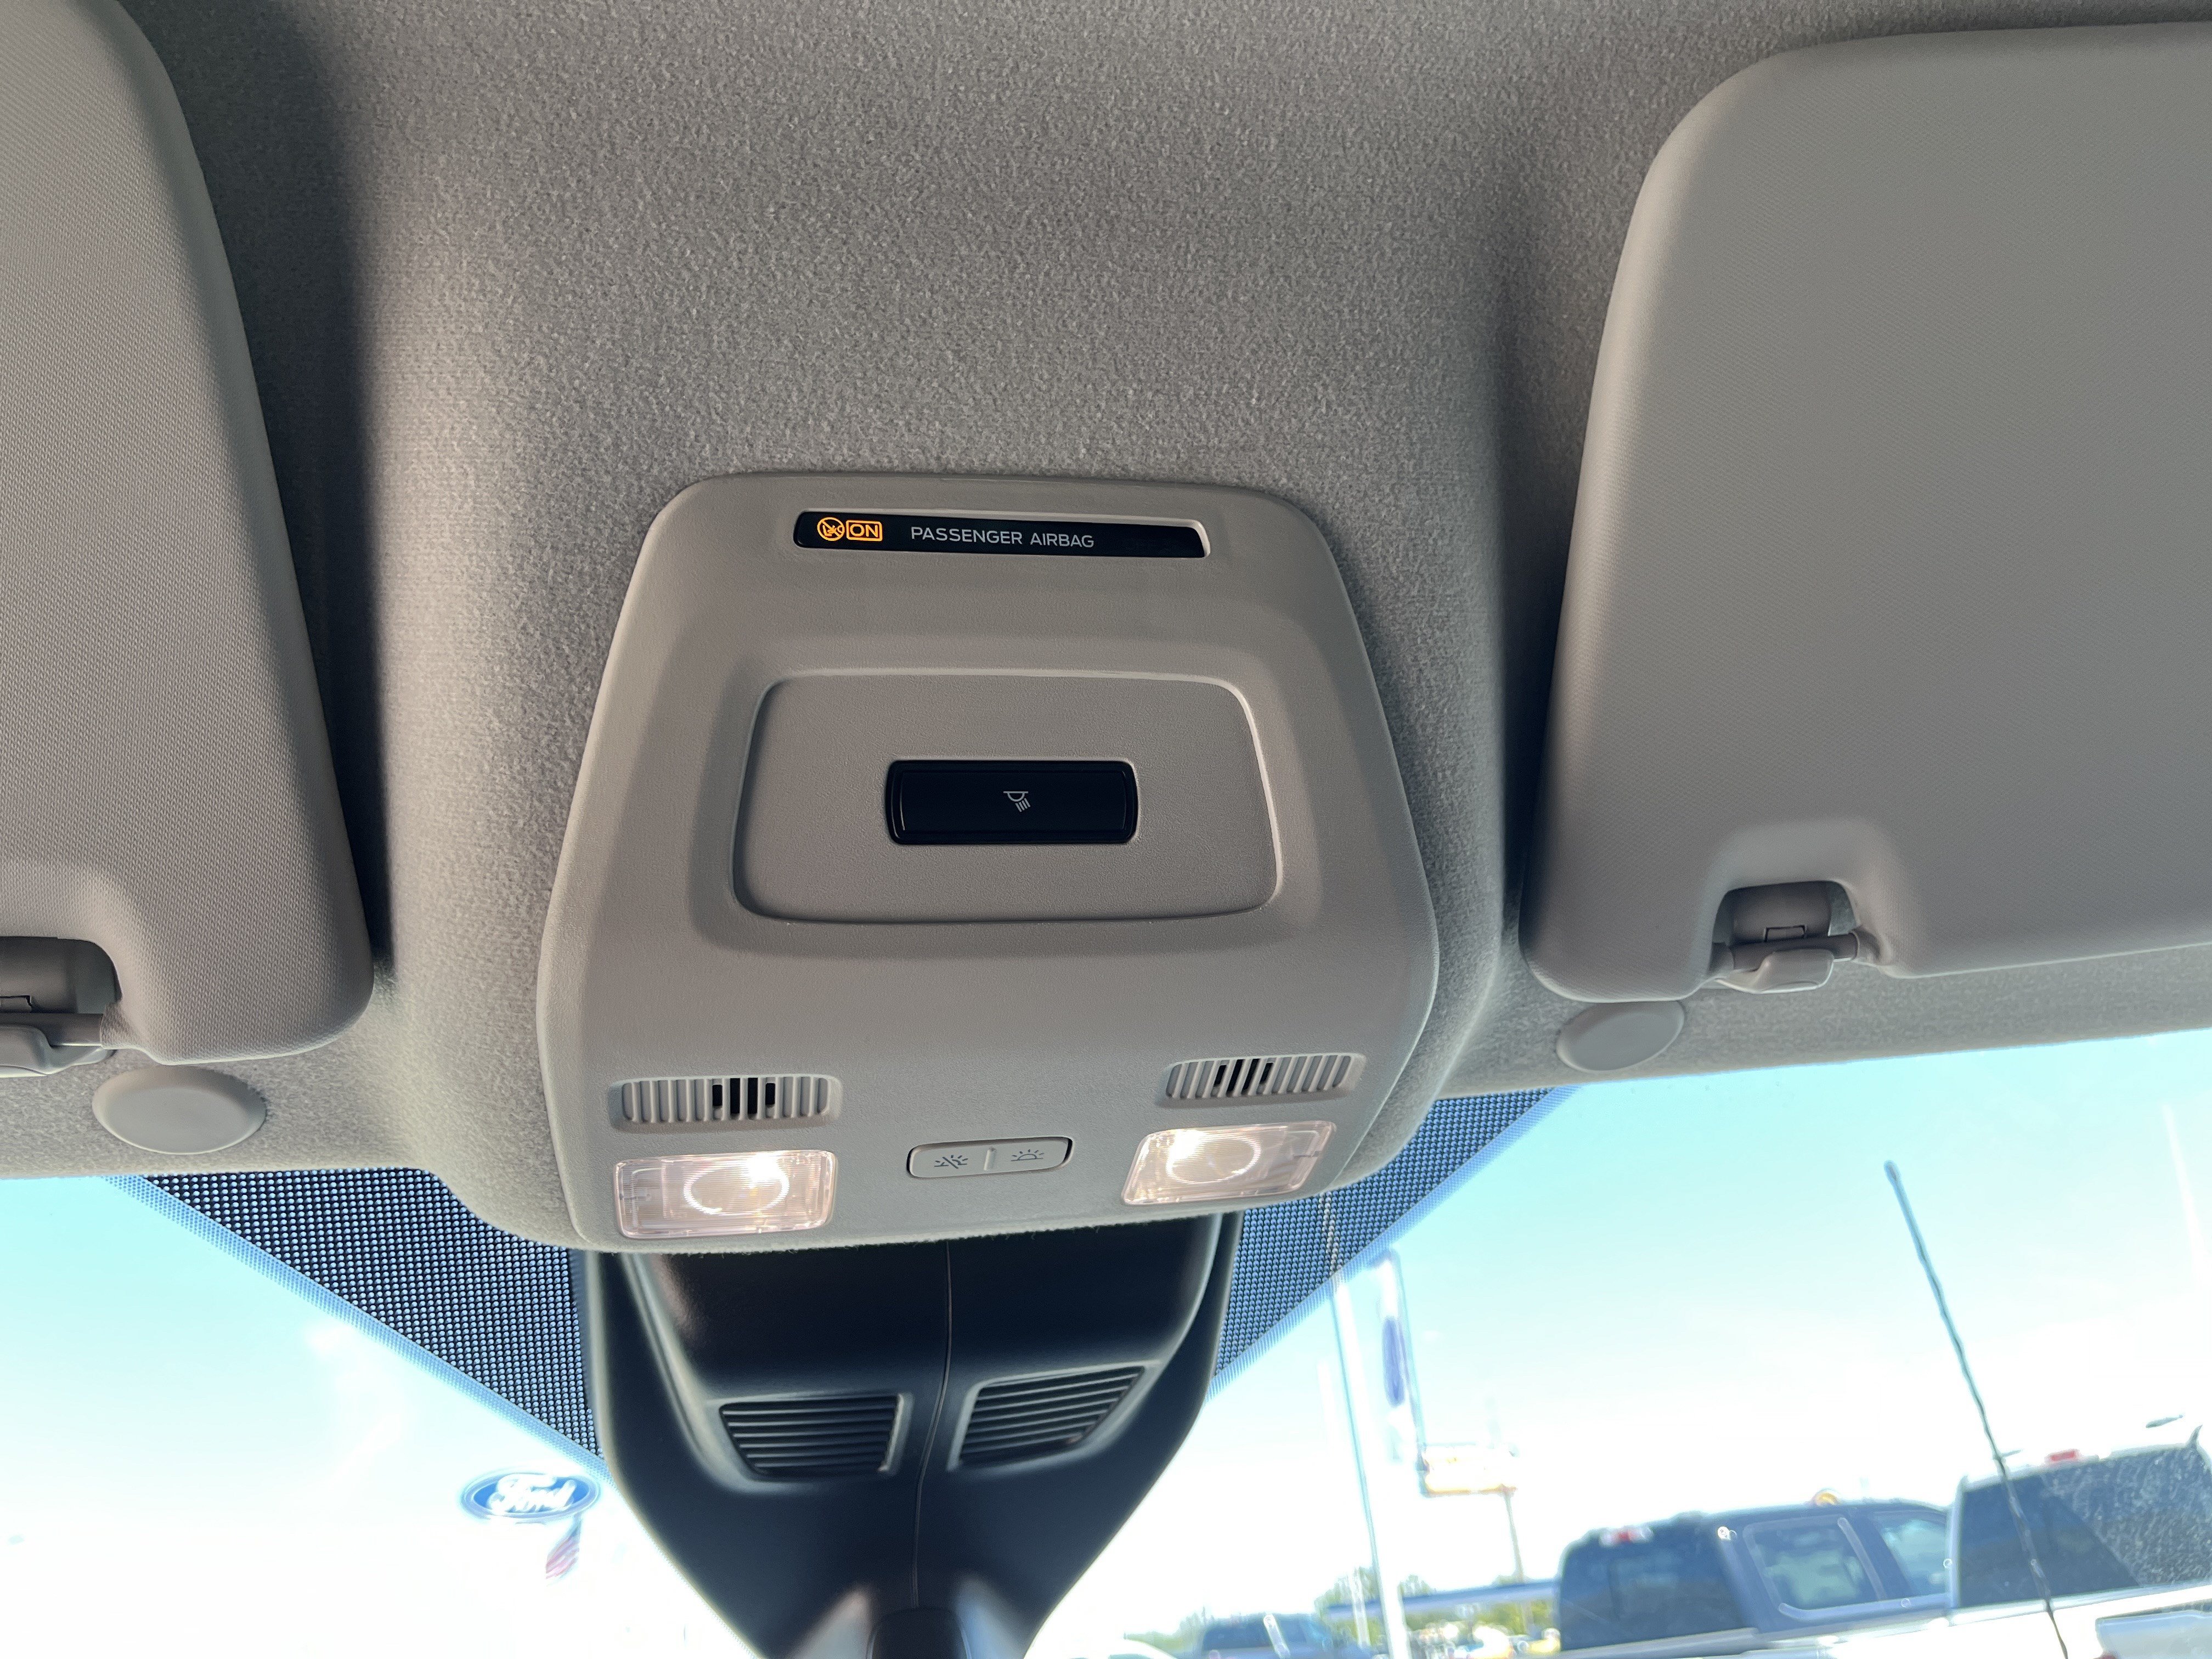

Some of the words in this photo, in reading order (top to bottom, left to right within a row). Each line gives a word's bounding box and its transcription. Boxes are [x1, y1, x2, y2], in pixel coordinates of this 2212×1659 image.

[850, 523, 878, 538] ON
[911, 527, 1023, 545] PASSENGER
[1030, 532, 1094, 548] AIRBAG
